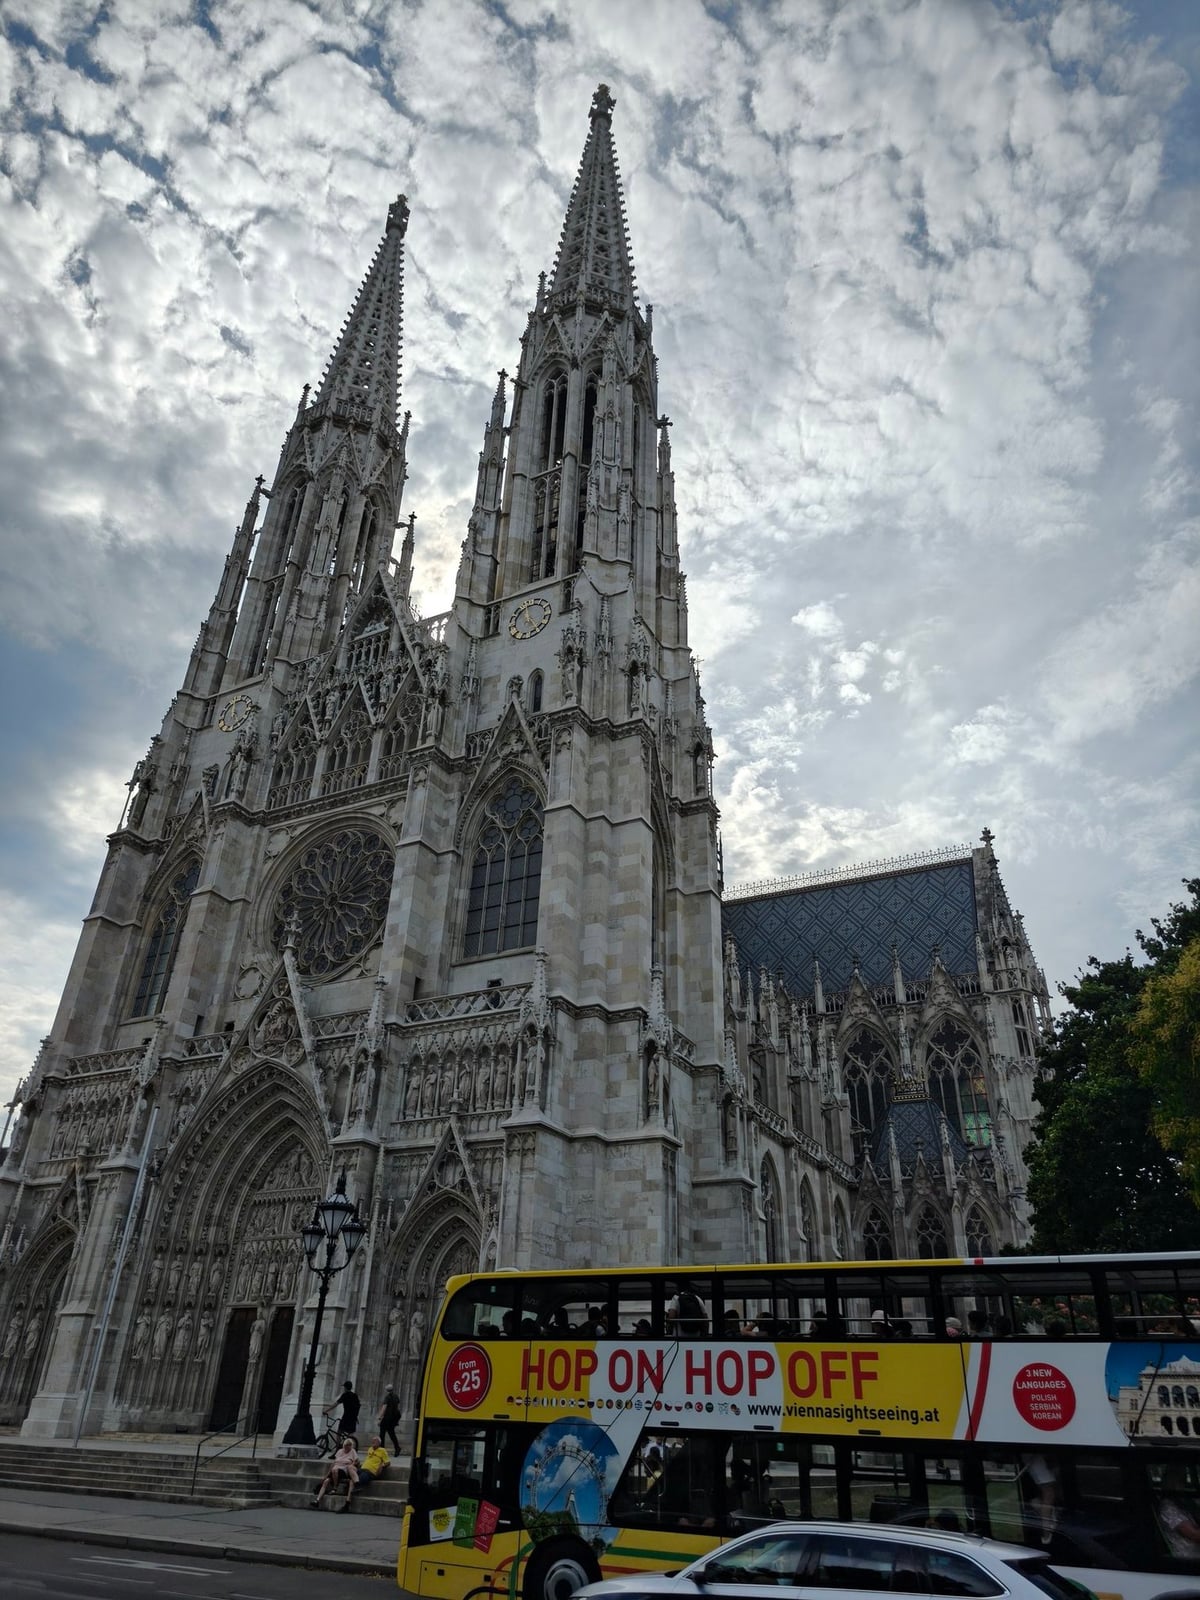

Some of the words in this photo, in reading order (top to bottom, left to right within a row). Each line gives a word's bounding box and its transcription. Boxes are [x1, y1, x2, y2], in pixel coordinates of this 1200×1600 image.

[458, 1359, 477, 1369] from
[521, 1348, 598, 1392] HOP
[608, 1349, 664, 1394] ON
[685, 1350, 775, 1396] HOP
[788, 1350, 879, 1399] OFF
[1025, 1369, 1031, 1377] 3
[1032, 1369, 1052, 1377] NEW
[453, 1369, 481, 1394] €25
[1016, 1380, 1066, 1389] LANGUAGES
[1030, 1402, 1061, 1411] SERBIAN
[747, 1402, 940, 1425] www.viennasightseeing.at
[1032, 1412, 1061, 1420] KOREAN
